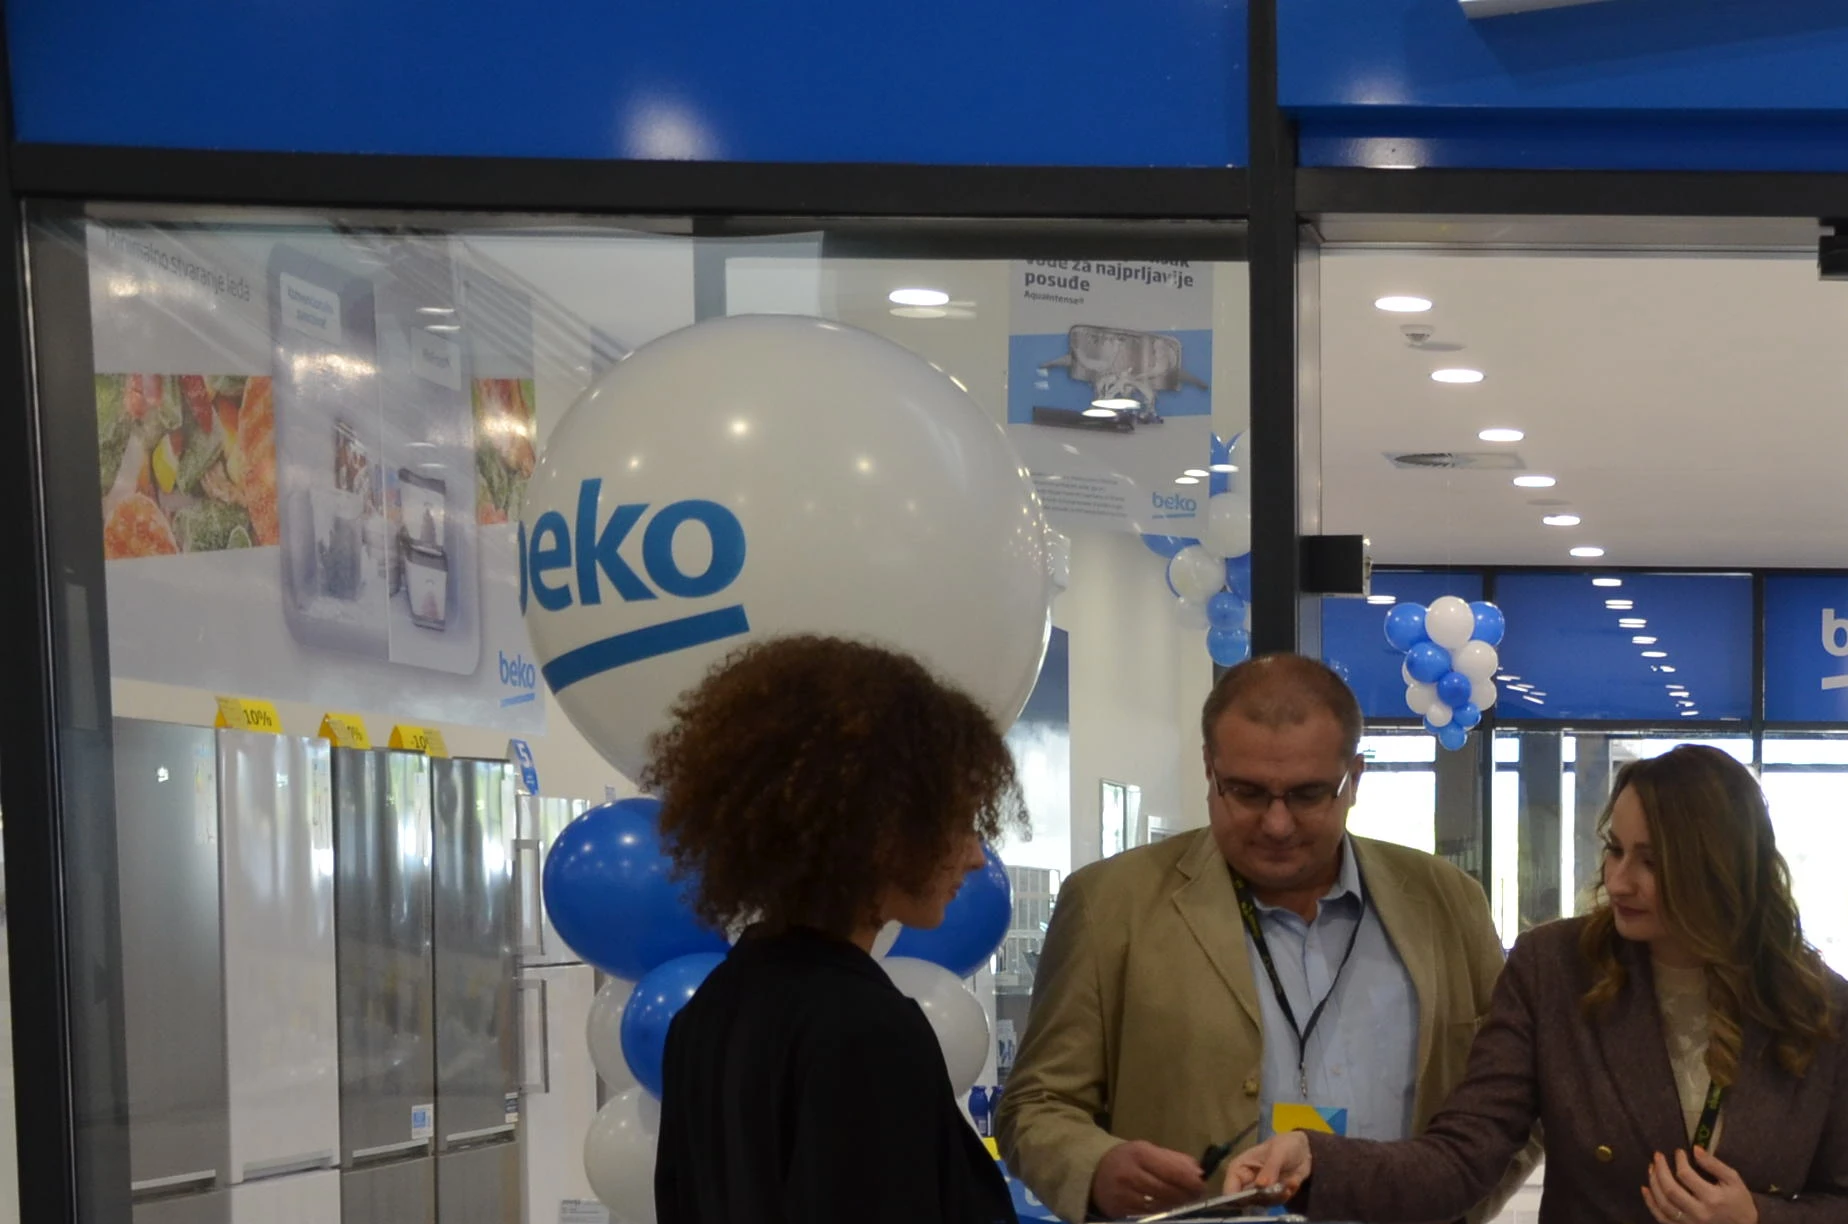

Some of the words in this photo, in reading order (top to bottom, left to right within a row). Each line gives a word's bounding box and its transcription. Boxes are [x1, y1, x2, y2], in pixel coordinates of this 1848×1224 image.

[1072, 260, 1092, 273] za
[1025, 272, 1090, 291] posuđe
[1152, 491, 1197, 512] beko
[518, 478, 747, 617] eko
[499, 650, 536, 689] beko
